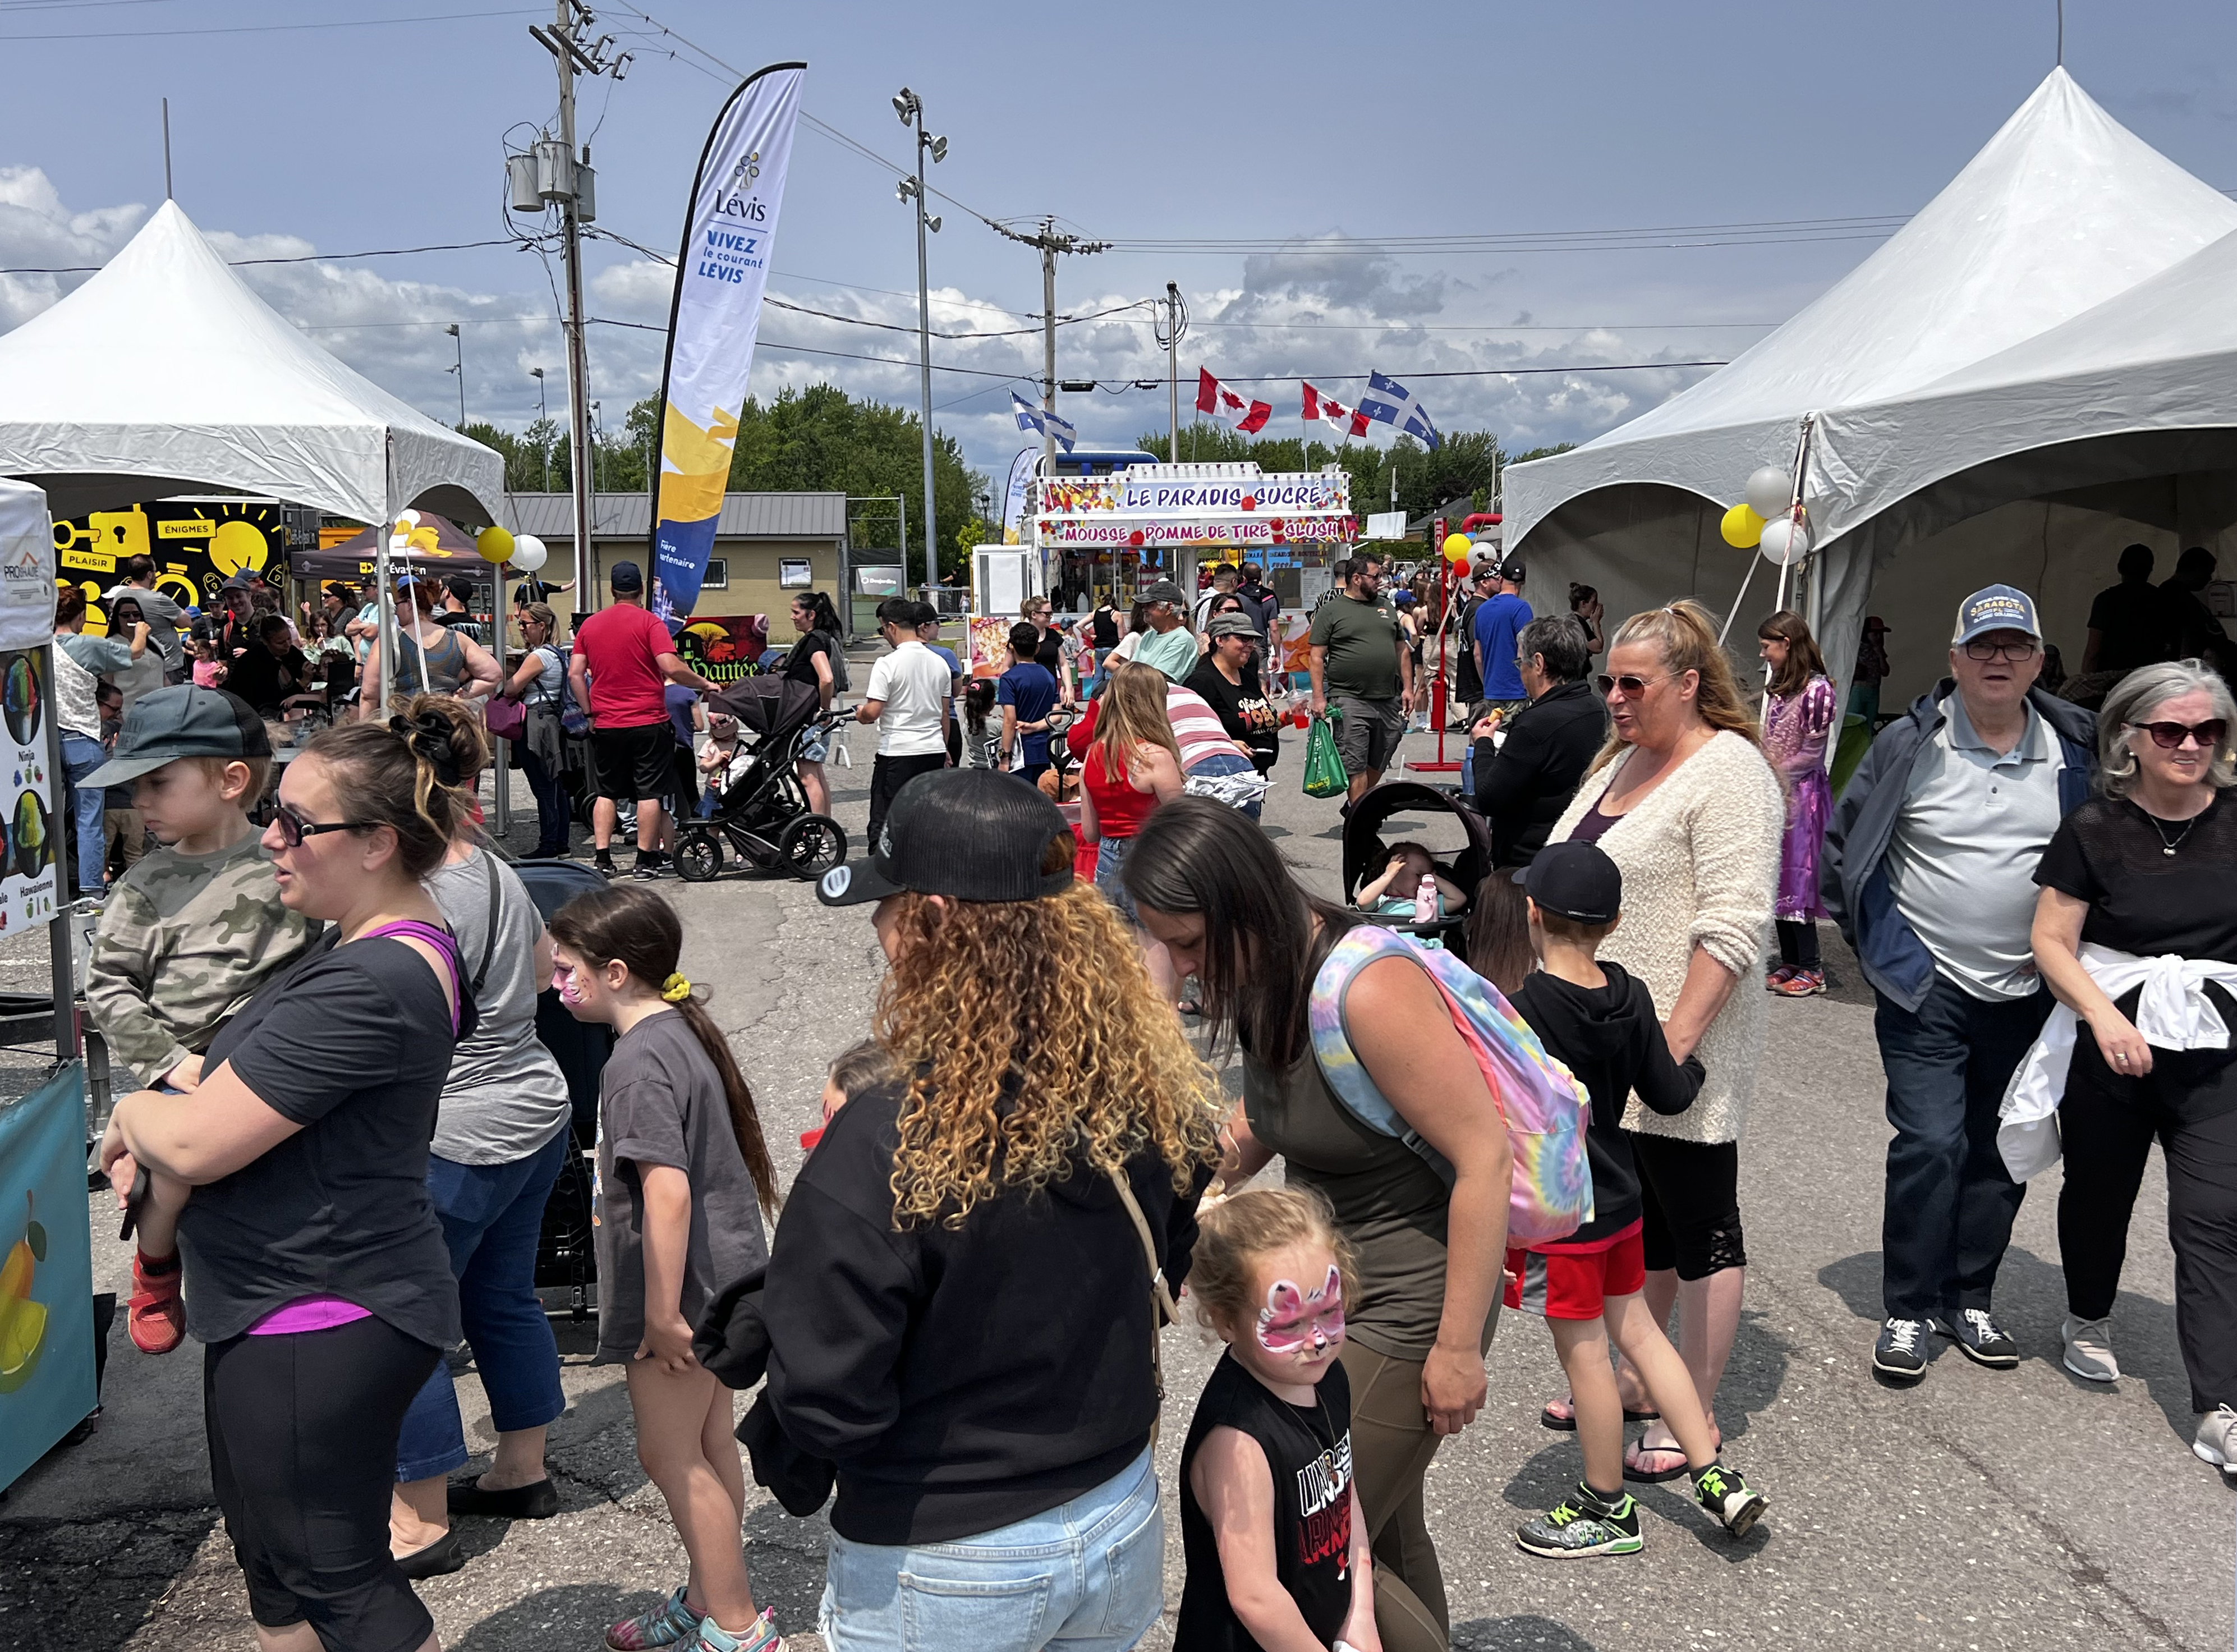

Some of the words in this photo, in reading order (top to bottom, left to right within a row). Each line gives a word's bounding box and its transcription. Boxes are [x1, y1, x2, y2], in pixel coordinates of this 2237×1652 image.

[715, 189, 766, 222] Lévis
[708, 230, 757, 254] VIVEZ
[704, 246, 714, 259] le
[718, 252, 763, 269] courant
[698, 261, 745, 283] LÉVIS
[1127, 489, 1151, 506] LE
[1157, 487, 1242, 507] PARADIS
[1254, 481, 1321, 505] SUCRÉ
[165, 524, 209, 534] ÉNIGMES
[1065, 527, 1127, 541] MOUSSE
[1145, 526, 1204, 540] POMME
[1207, 525, 1227, 539] DE
[1232, 525, 1270, 539] TIRE
[1284, 522, 1339, 538] SLUSH
[68, 555, 108, 567] PLAISIR
[1970, 600, 2026, 616] SARASOTA
[18, 750, 35, 764] Ninja
